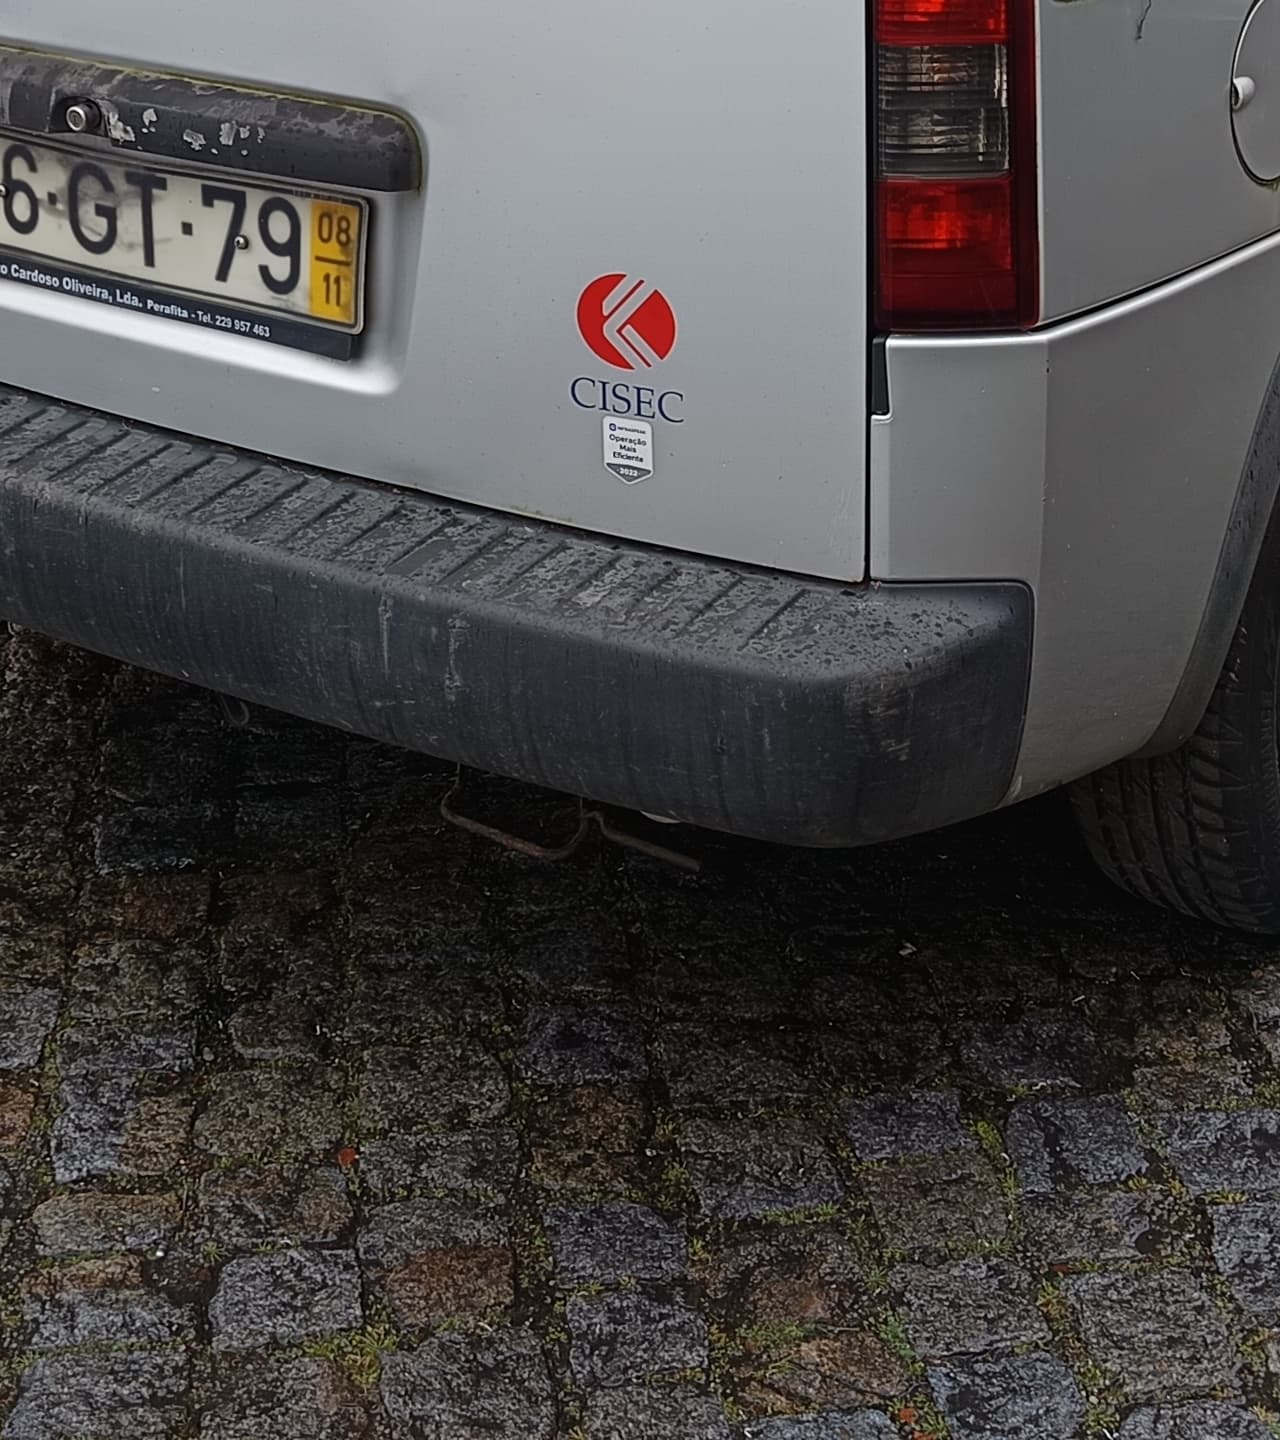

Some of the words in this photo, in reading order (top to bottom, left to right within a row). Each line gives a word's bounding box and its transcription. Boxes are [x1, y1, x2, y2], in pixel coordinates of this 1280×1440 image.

[317, 211, 351, 247] 08
[11, 264, 60, 288] Cardoso
[62, 277, 113, 303] Oliveira,
[116, 289, 143, 308] Lda.
[146, 299, 189, 319] Perafita
[196, 311, 213, 324] Tel.
[215, 315, 232, 329] 229
[233, 319, 251, 333] 957
[252, 323, 271, 338] 463
[322, 272, 342, 307] 11
[570, 376, 685, 424] CISEC
[609, 433, 647, 447] Operação
[619, 443, 637, 453] Mais
